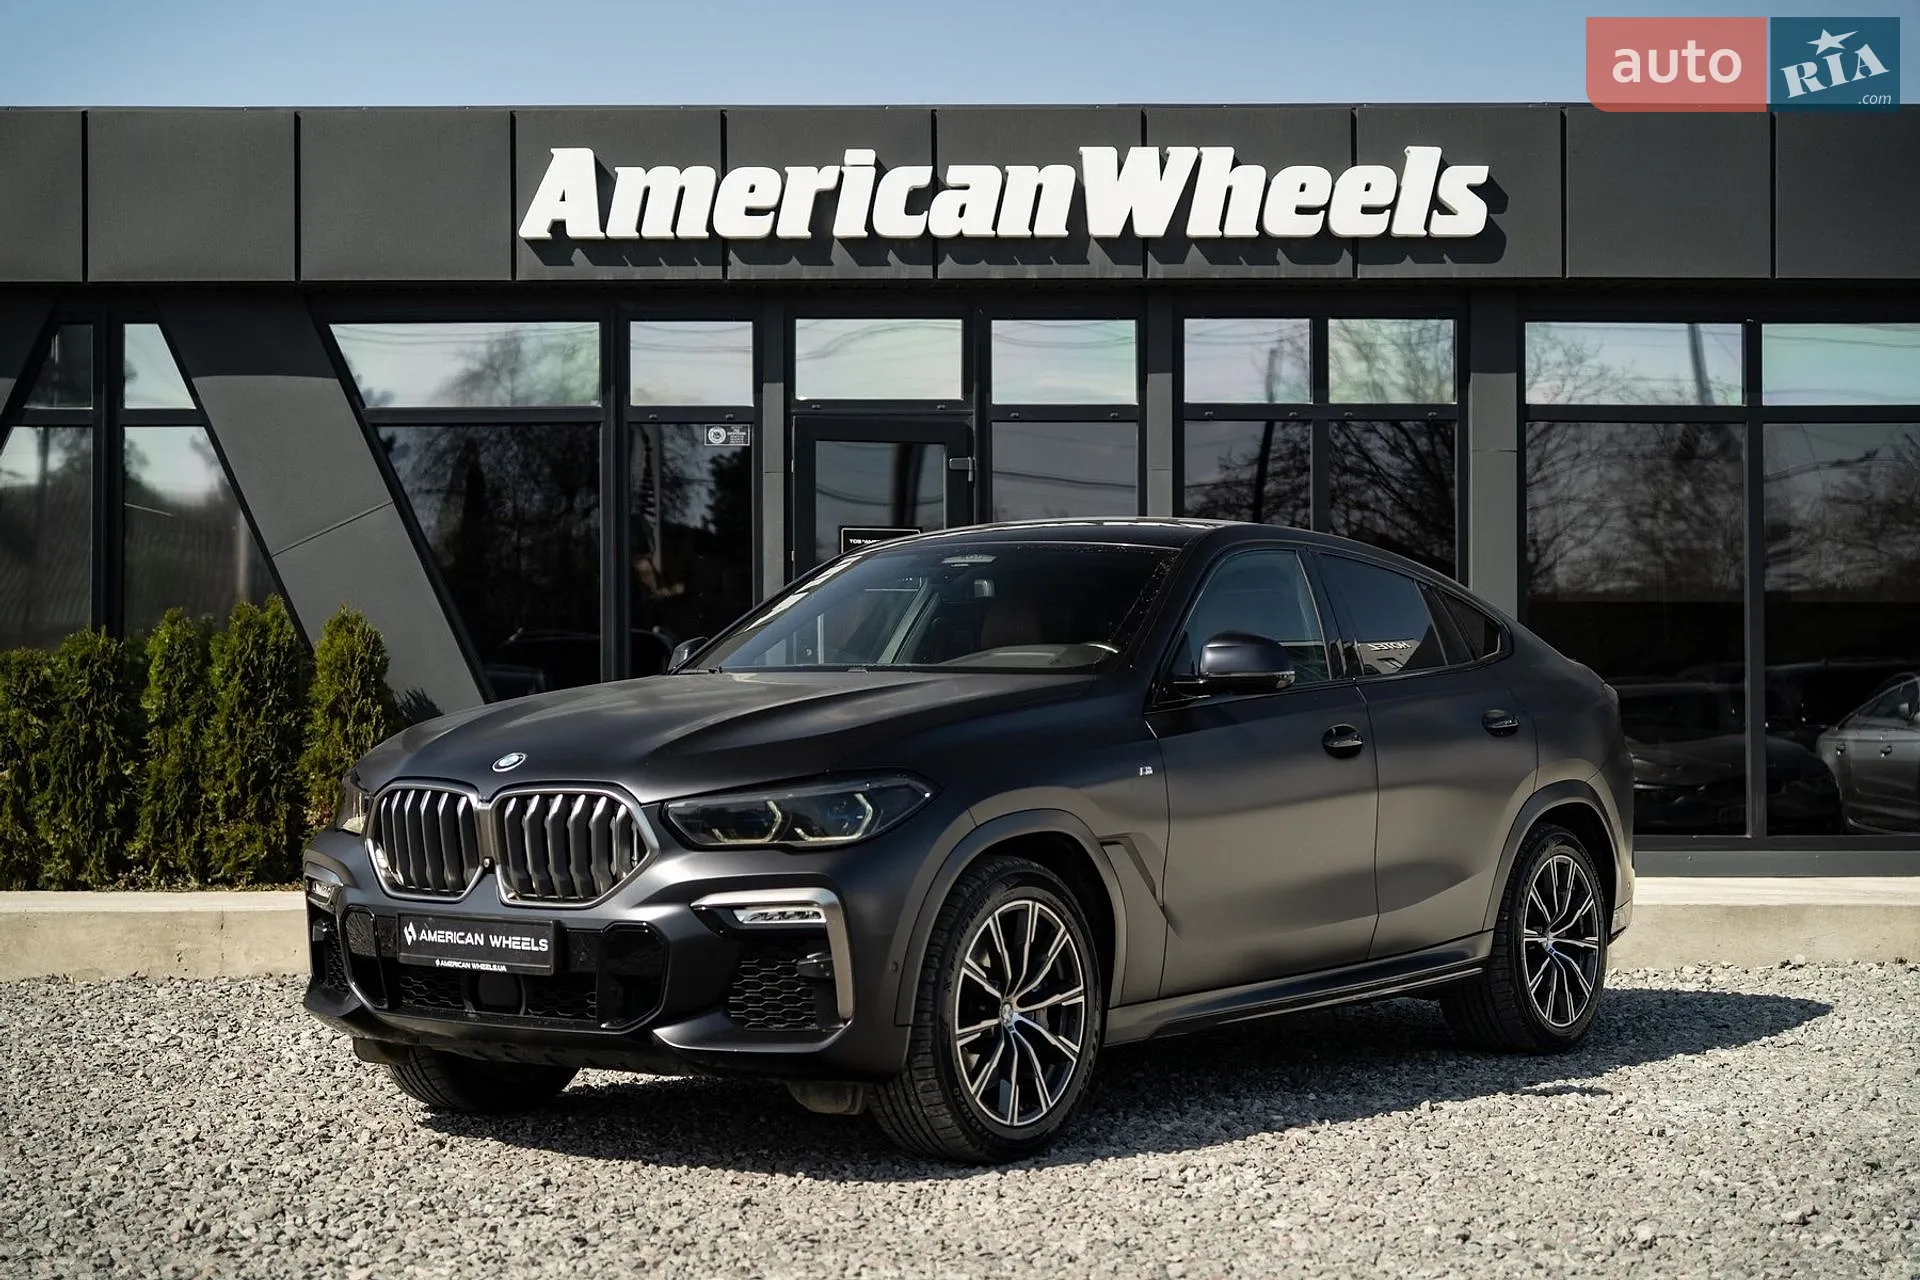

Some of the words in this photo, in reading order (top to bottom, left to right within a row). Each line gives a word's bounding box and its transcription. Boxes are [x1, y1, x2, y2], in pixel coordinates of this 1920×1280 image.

[419, 928, 485, 946] AMERICAN
[489, 934, 549, 952] WHEELS
[440, 959, 471, 970] AMERICAN
